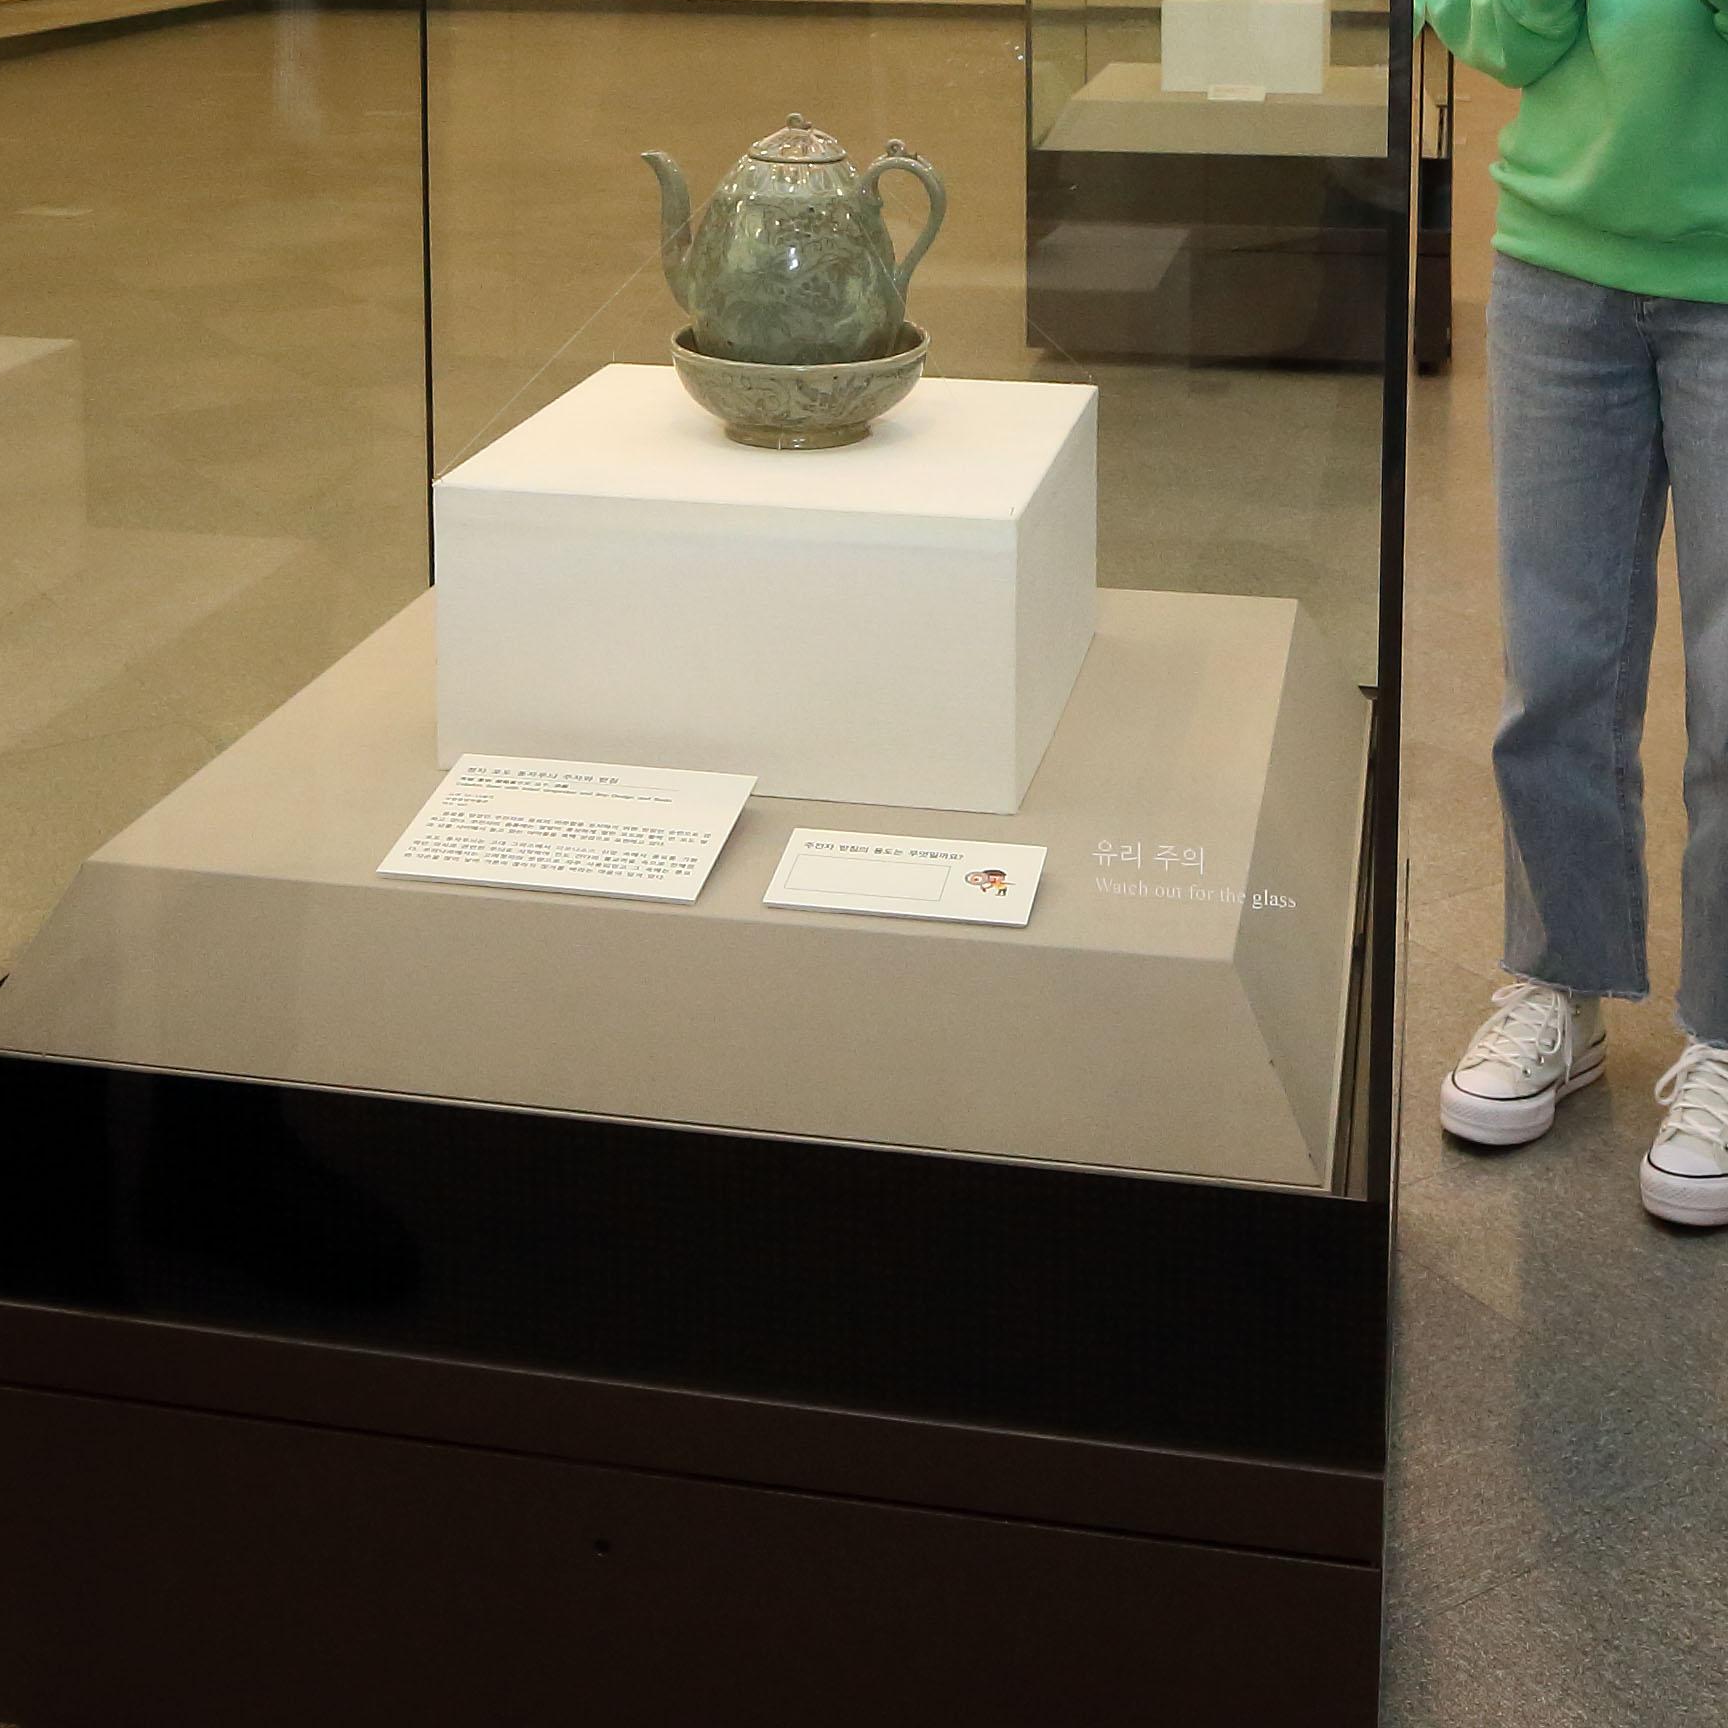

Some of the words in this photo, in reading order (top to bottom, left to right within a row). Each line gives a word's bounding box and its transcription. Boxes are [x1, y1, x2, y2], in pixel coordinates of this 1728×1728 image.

[1091, 839, 1142, 871] 유리
[1151, 844, 1204, 876] 주의
[1095, 876, 1149, 898] Watch
[1155, 884, 1183, 899] out
[1189, 883, 1215, 902] for
[1219, 886, 1247, 905] the
[1251, 889, 1297, 910] glass
